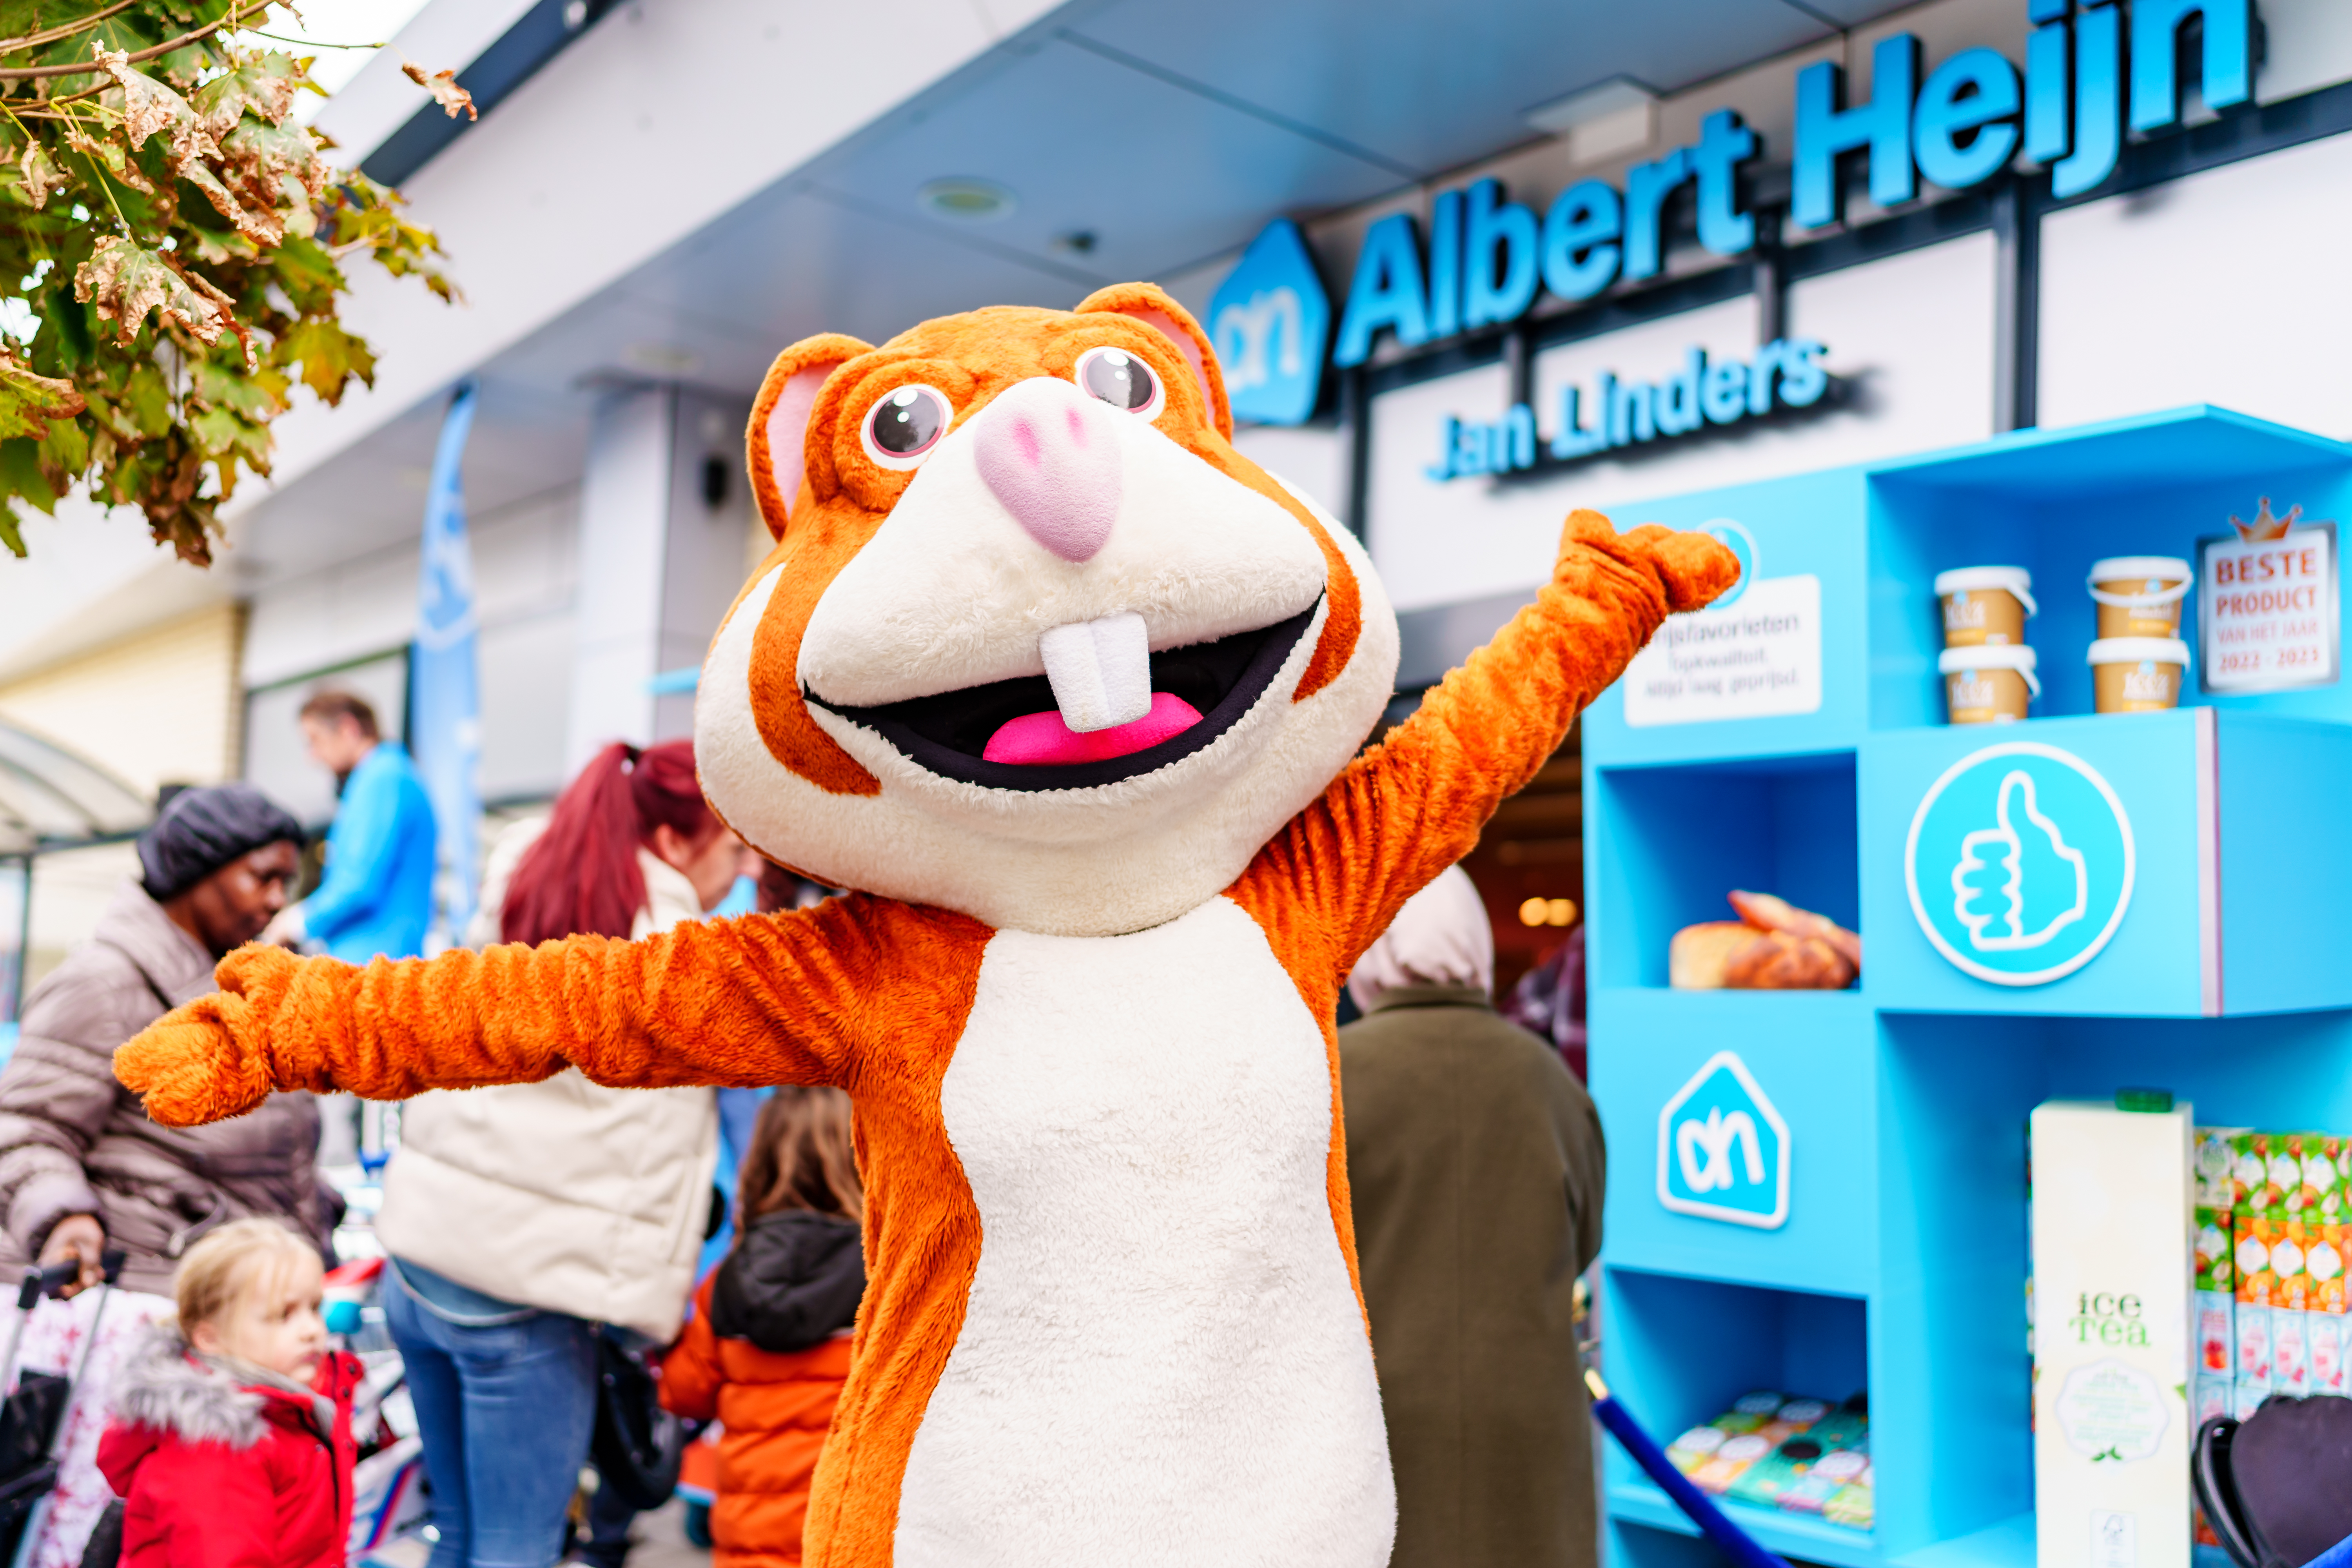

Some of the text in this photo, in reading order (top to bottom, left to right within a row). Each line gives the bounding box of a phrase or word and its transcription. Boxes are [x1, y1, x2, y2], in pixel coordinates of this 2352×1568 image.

[1332, 0, 2250, 369] Albert Heijn
[1425, 337, 1829, 483] Jan Linders
[2216, 548, 2316, 585] BESTE
[2216, 585, 2316, 618] PRODUCT
[1653, 613, 1799, 648] rijsfavorieten
[2217, 616, 2318, 644] VAN HET JAAR
[2219, 651, 2261, 673] 2022
[2277, 645, 2319, 669] 2023
